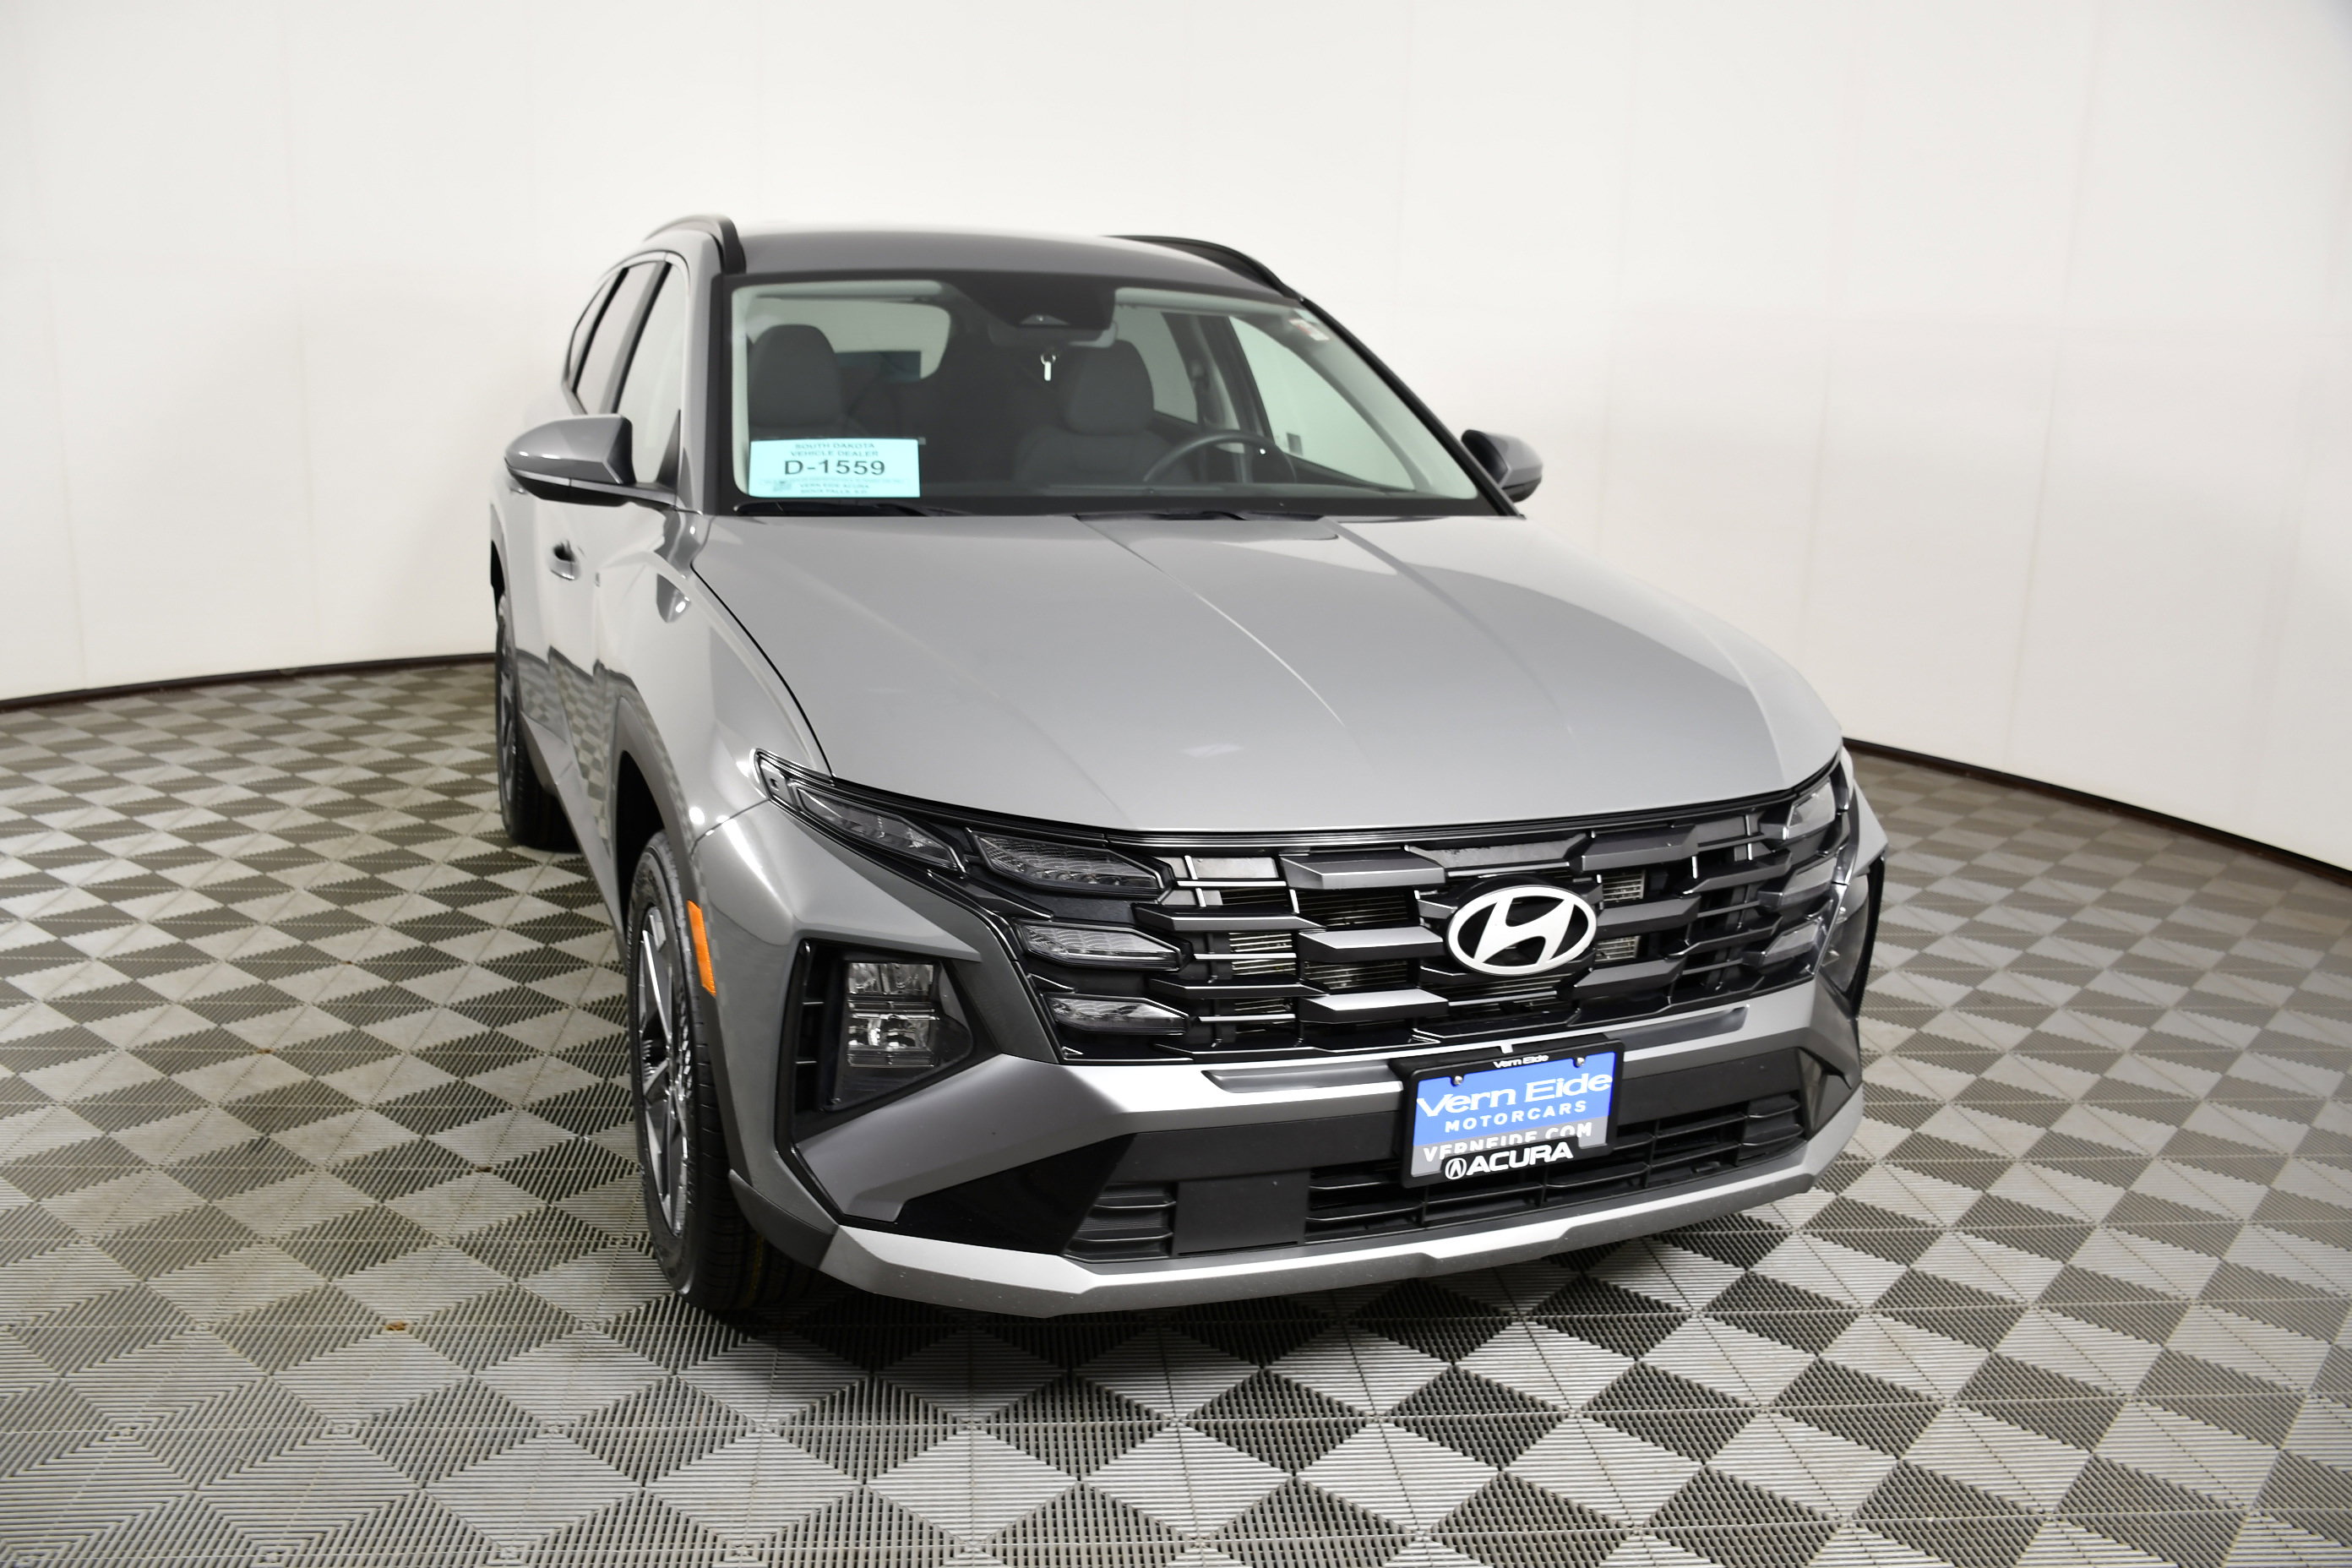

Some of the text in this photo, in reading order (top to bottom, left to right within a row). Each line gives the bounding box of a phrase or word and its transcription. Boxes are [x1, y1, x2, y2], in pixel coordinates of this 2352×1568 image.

[784, 459, 885, 476] D-1559
[1493, 1054, 1549, 1069] Vern Eide
[1416, 1072, 1613, 1117] Vern Eide
[1445, 1100, 1587, 1133] MOTORCARS
[1466, 1141, 1574, 1176] ACURA
